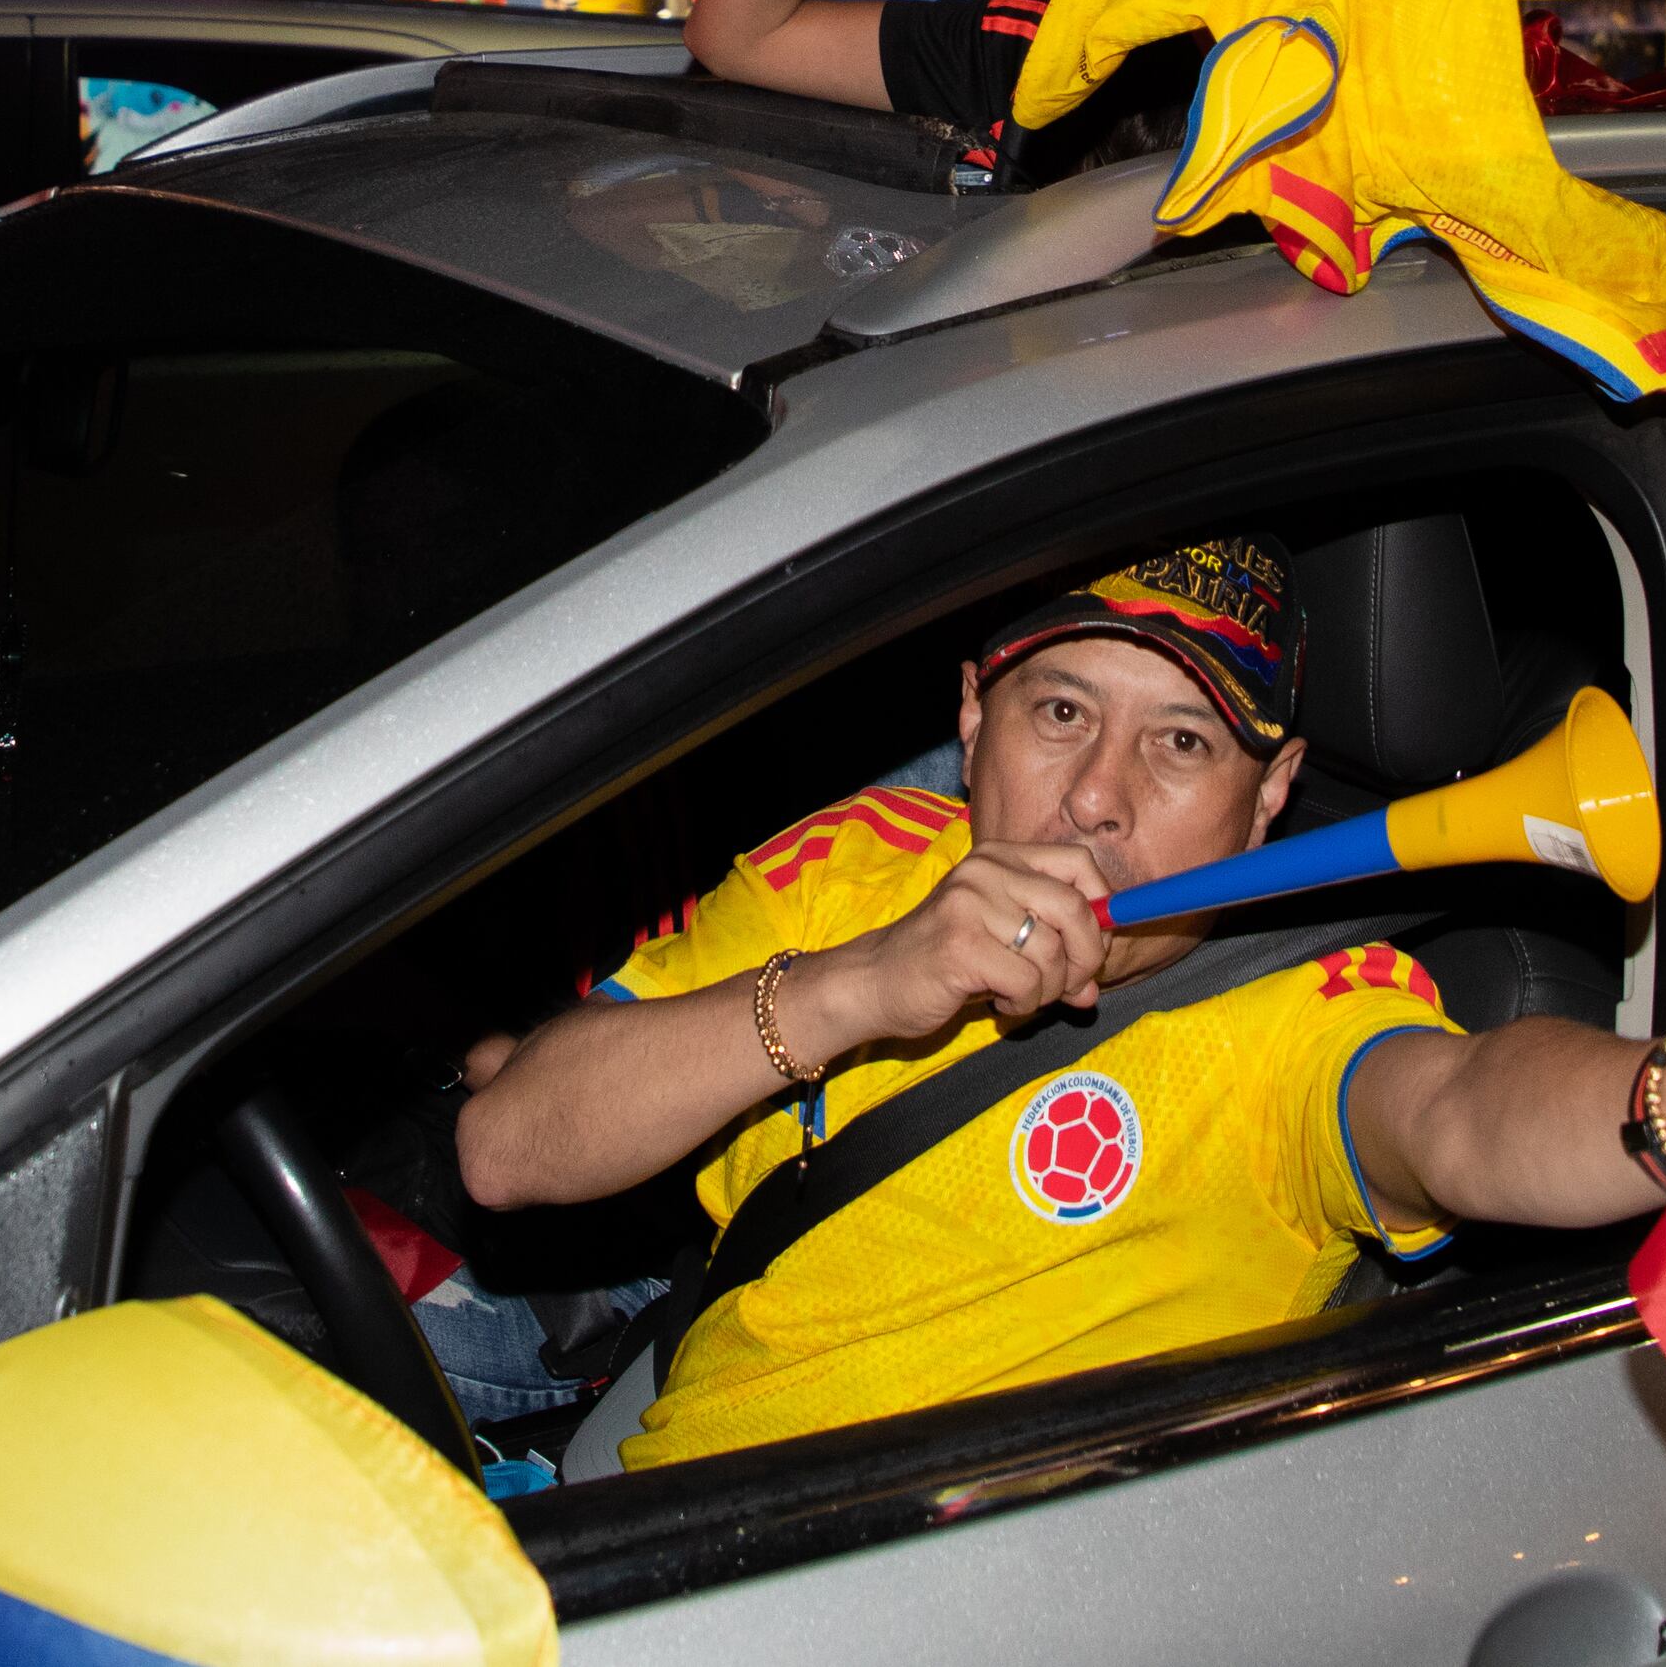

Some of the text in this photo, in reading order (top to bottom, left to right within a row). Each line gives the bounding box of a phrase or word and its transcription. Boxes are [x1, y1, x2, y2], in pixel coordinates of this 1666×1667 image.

[1183, 546, 1254, 591] OR LA
[1131, 557, 1269, 651] PATRIA
[1068, 1076, 1123, 1105] COLOMBIANA
[1119, 1102, 1131, 1118] DE
